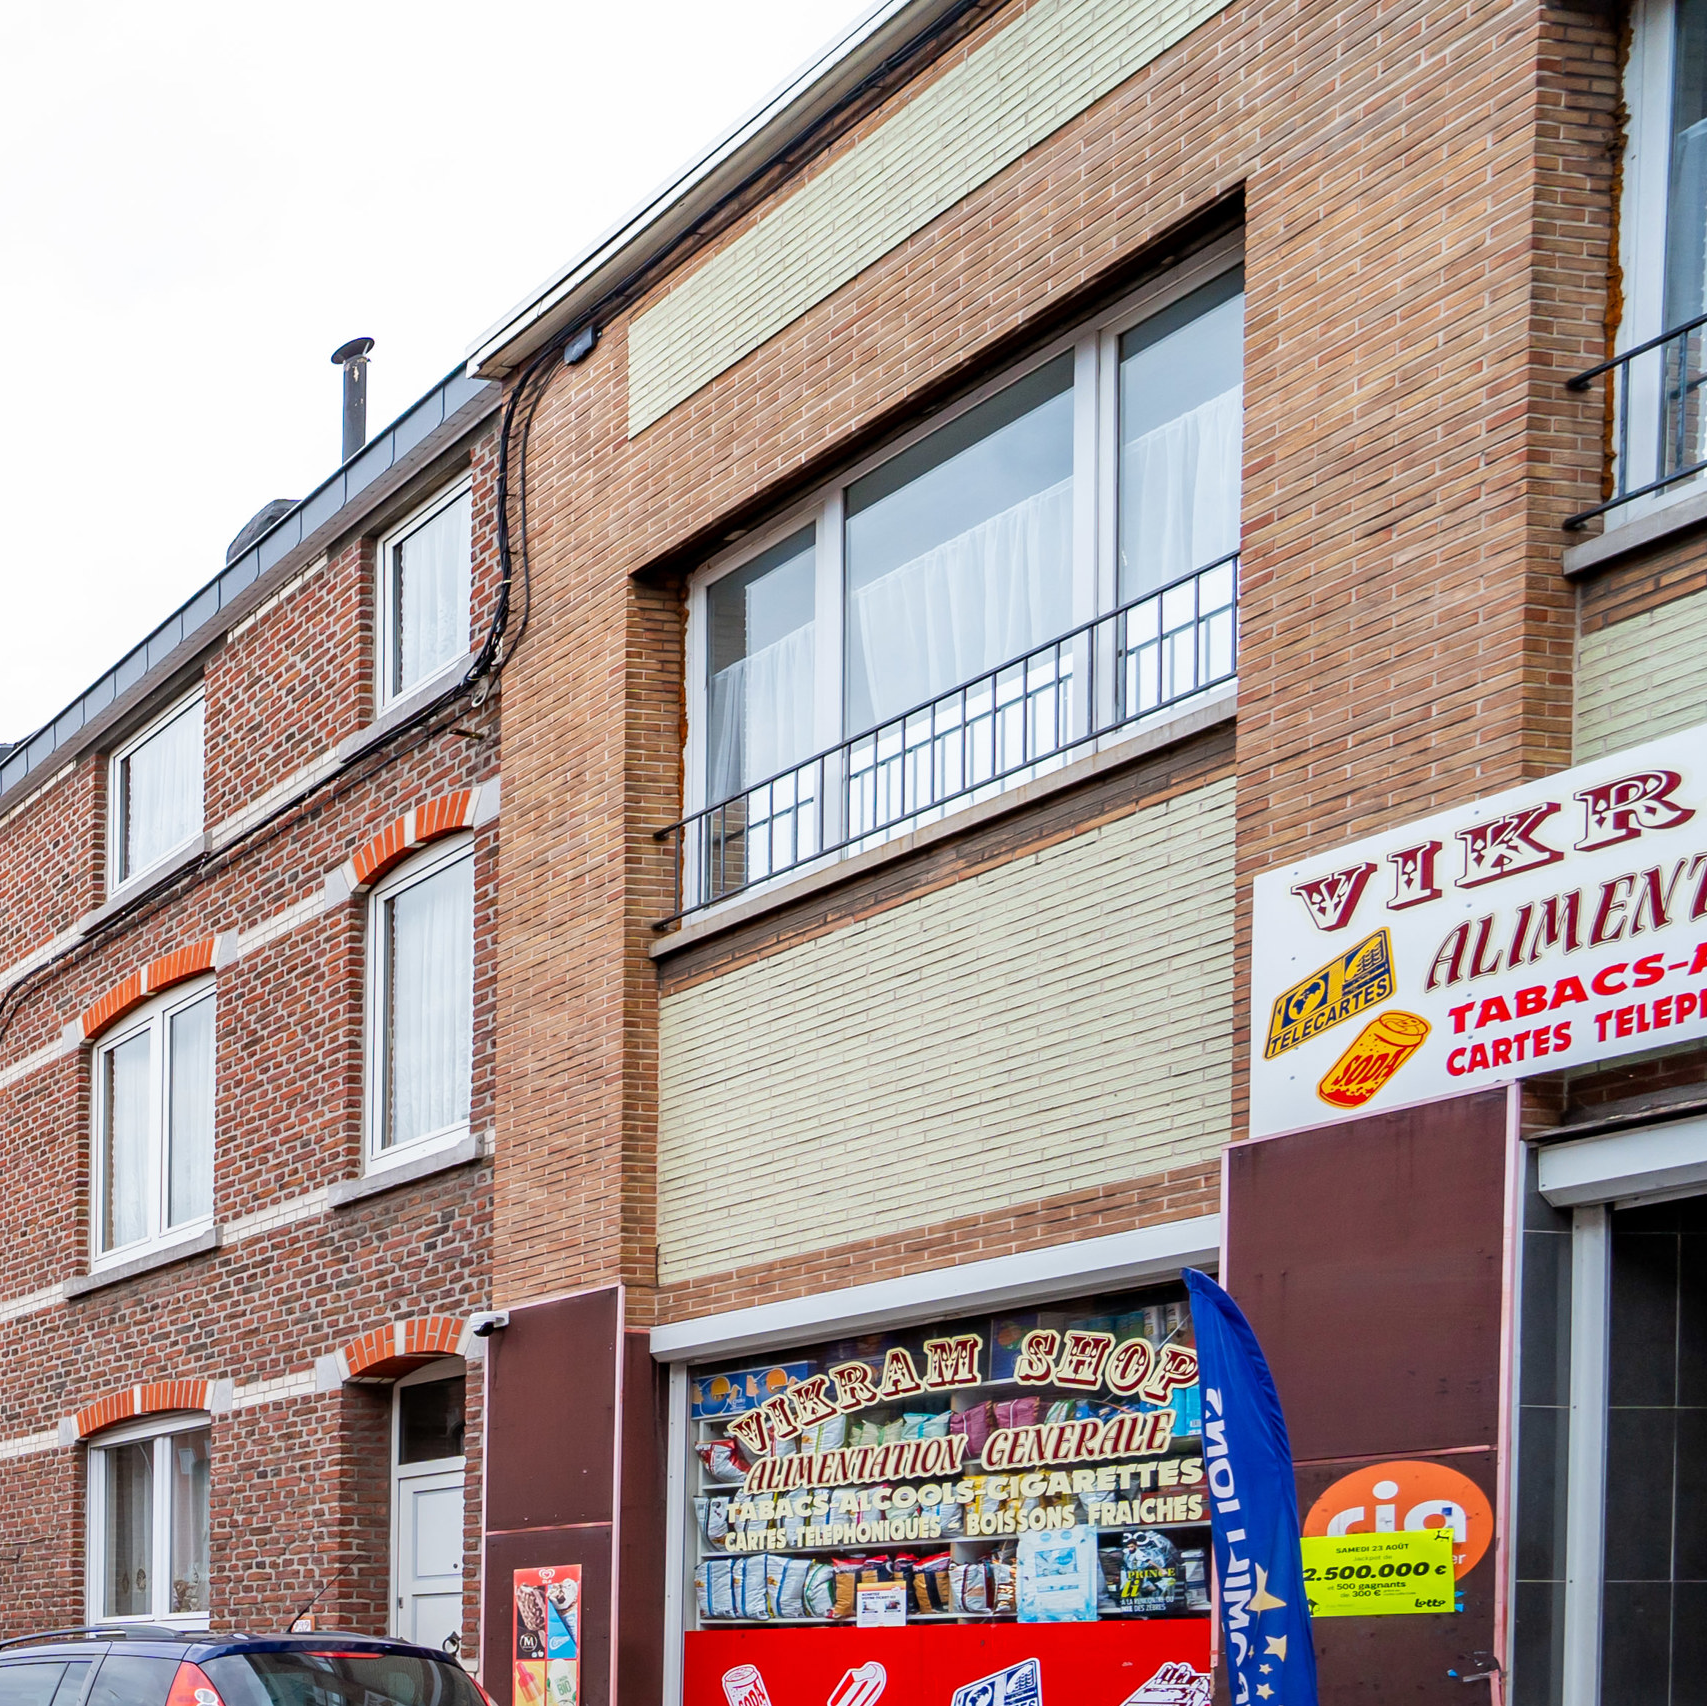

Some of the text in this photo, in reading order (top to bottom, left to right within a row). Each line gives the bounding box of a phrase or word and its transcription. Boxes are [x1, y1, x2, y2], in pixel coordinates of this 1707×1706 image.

[1291, 769, 1696, 932] VIKR
[1271, 978, 1387, 1055] TELECARTES
[1331, 1046, 1407, 1086] SODA
[1446, 1021, 1572, 1076] CARTES
[729, 1330, 1200, 1453] VIKRAM SHOP
[745, 1410, 1175, 1494] ALIMENTATION GENERALE
[725, 1528, 786, 1551] CARTES
[797, 1516, 941, 1547] TELEPHONIQUES
[967, 1504, 1076, 1536] BOISSONS
[1088, 1494, 1203, 1526] FRAICHES
[1385, 1543, 1409, 1551] AOÛT
[1127, 1567, 1176, 1579] PRINCE
[1303, 1562, 1446, 1581] 2.500.000 €
[1358, 1581, 1406, 1590] gagnants
